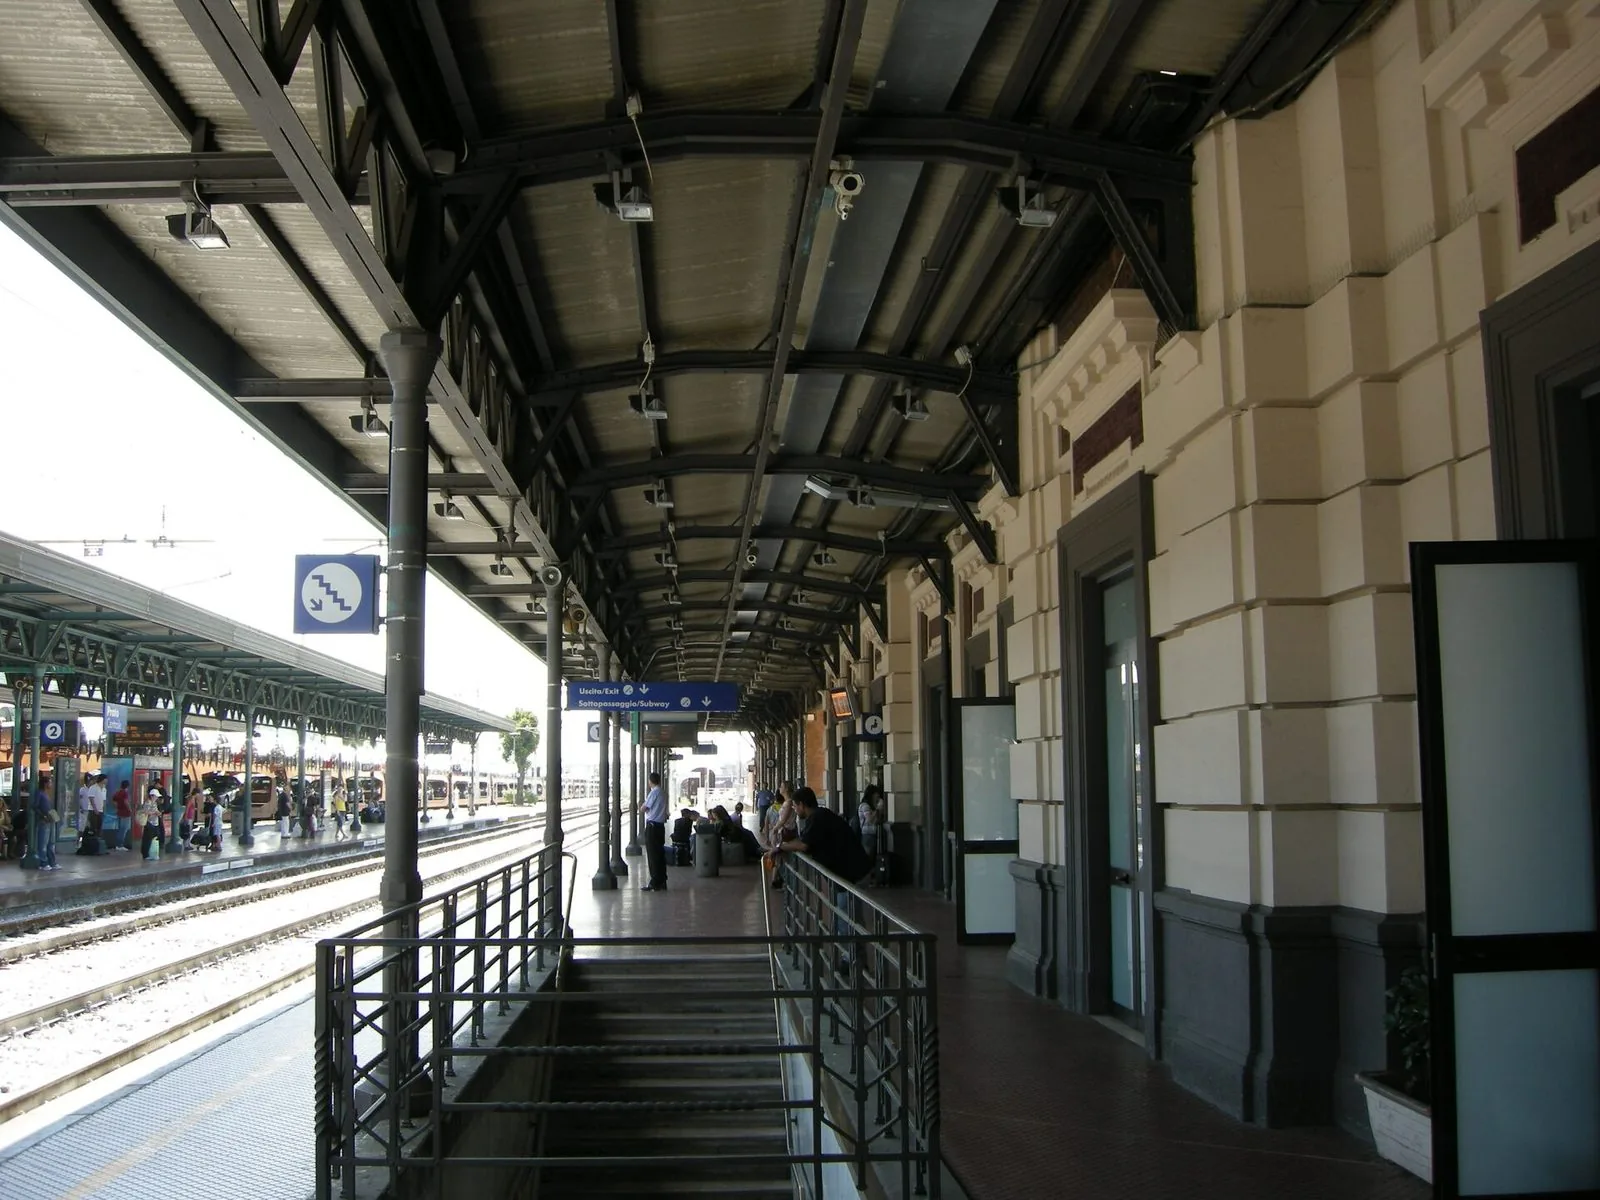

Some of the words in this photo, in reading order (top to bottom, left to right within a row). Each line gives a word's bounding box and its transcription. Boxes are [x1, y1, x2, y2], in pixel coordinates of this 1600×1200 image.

[579, 687, 619, 695] Uscita/Exit
[578, 700, 670, 709] Sottopassaggio/Subway
[49, 726, 58, 737] 2
